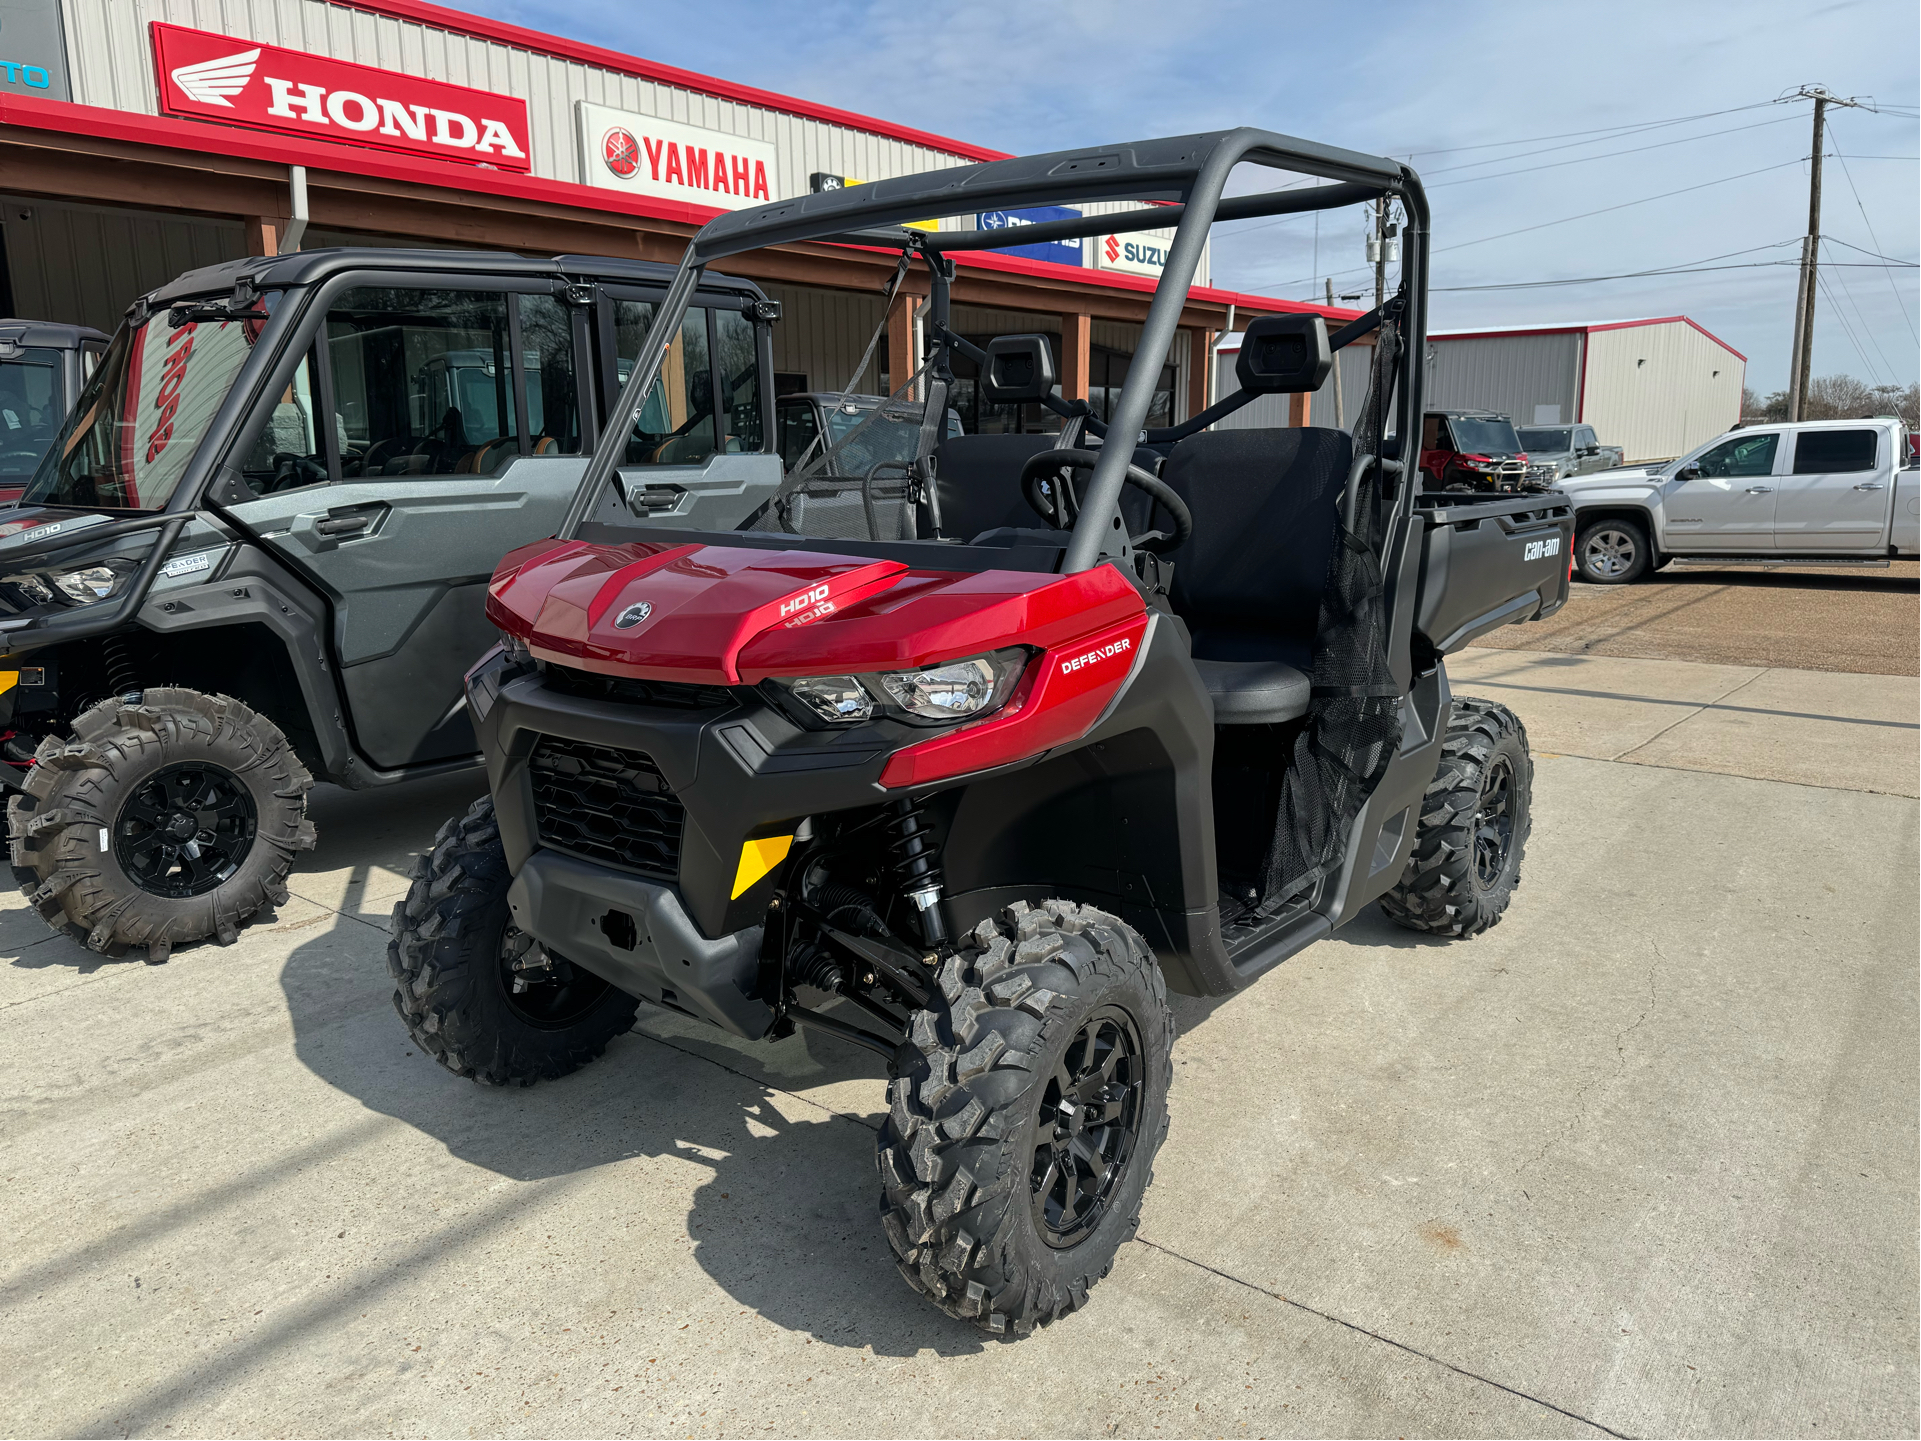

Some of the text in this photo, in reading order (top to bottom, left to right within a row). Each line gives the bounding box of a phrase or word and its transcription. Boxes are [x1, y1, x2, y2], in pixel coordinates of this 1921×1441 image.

[263, 76, 526, 159] HONDA
[642, 135, 770, 202] YAMAHA
[1124, 242, 1169, 267] SUZU
[24, 523, 62, 541] HD10
[1524, 537, 1560, 562] can-am
[780, 584, 829, 617] HD10
[1061, 638, 1131, 675] DEFENDER
